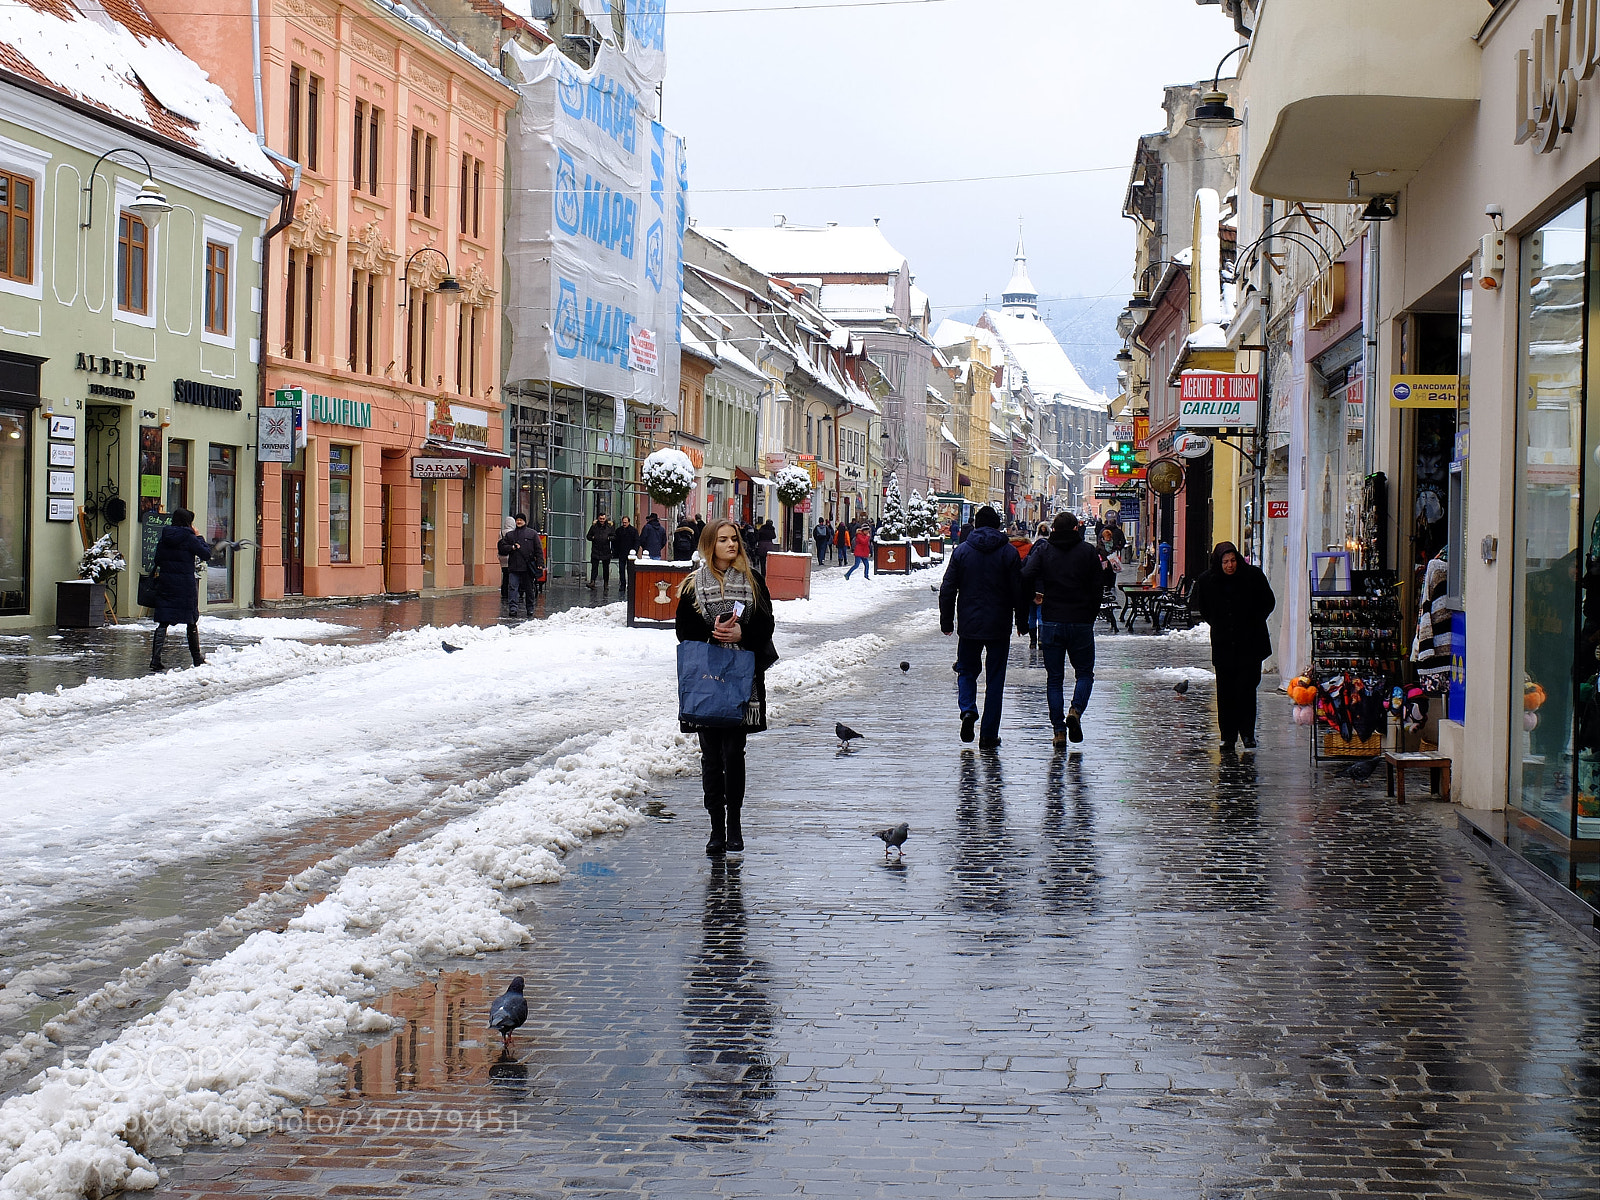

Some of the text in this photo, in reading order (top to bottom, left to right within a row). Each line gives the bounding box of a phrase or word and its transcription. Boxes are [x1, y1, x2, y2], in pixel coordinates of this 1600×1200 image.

[586, 73, 638, 155] MAPEI
[580, 173, 637, 260] MAPEI
[580, 296, 637, 371] MAPE
[76, 352, 146, 380] ALBERT
[173, 378, 243, 411] SOUVENIRS
[1183, 377, 1256, 398] AGENTIE DE TURISM
[311, 393, 372, 429] FUJIFILM
[639, 416, 661, 424] SERVCE
[1183, 402, 1240, 415] CARLIDA
[415, 463, 465, 472] SARAY
[702, 674, 725, 683] ZARA
